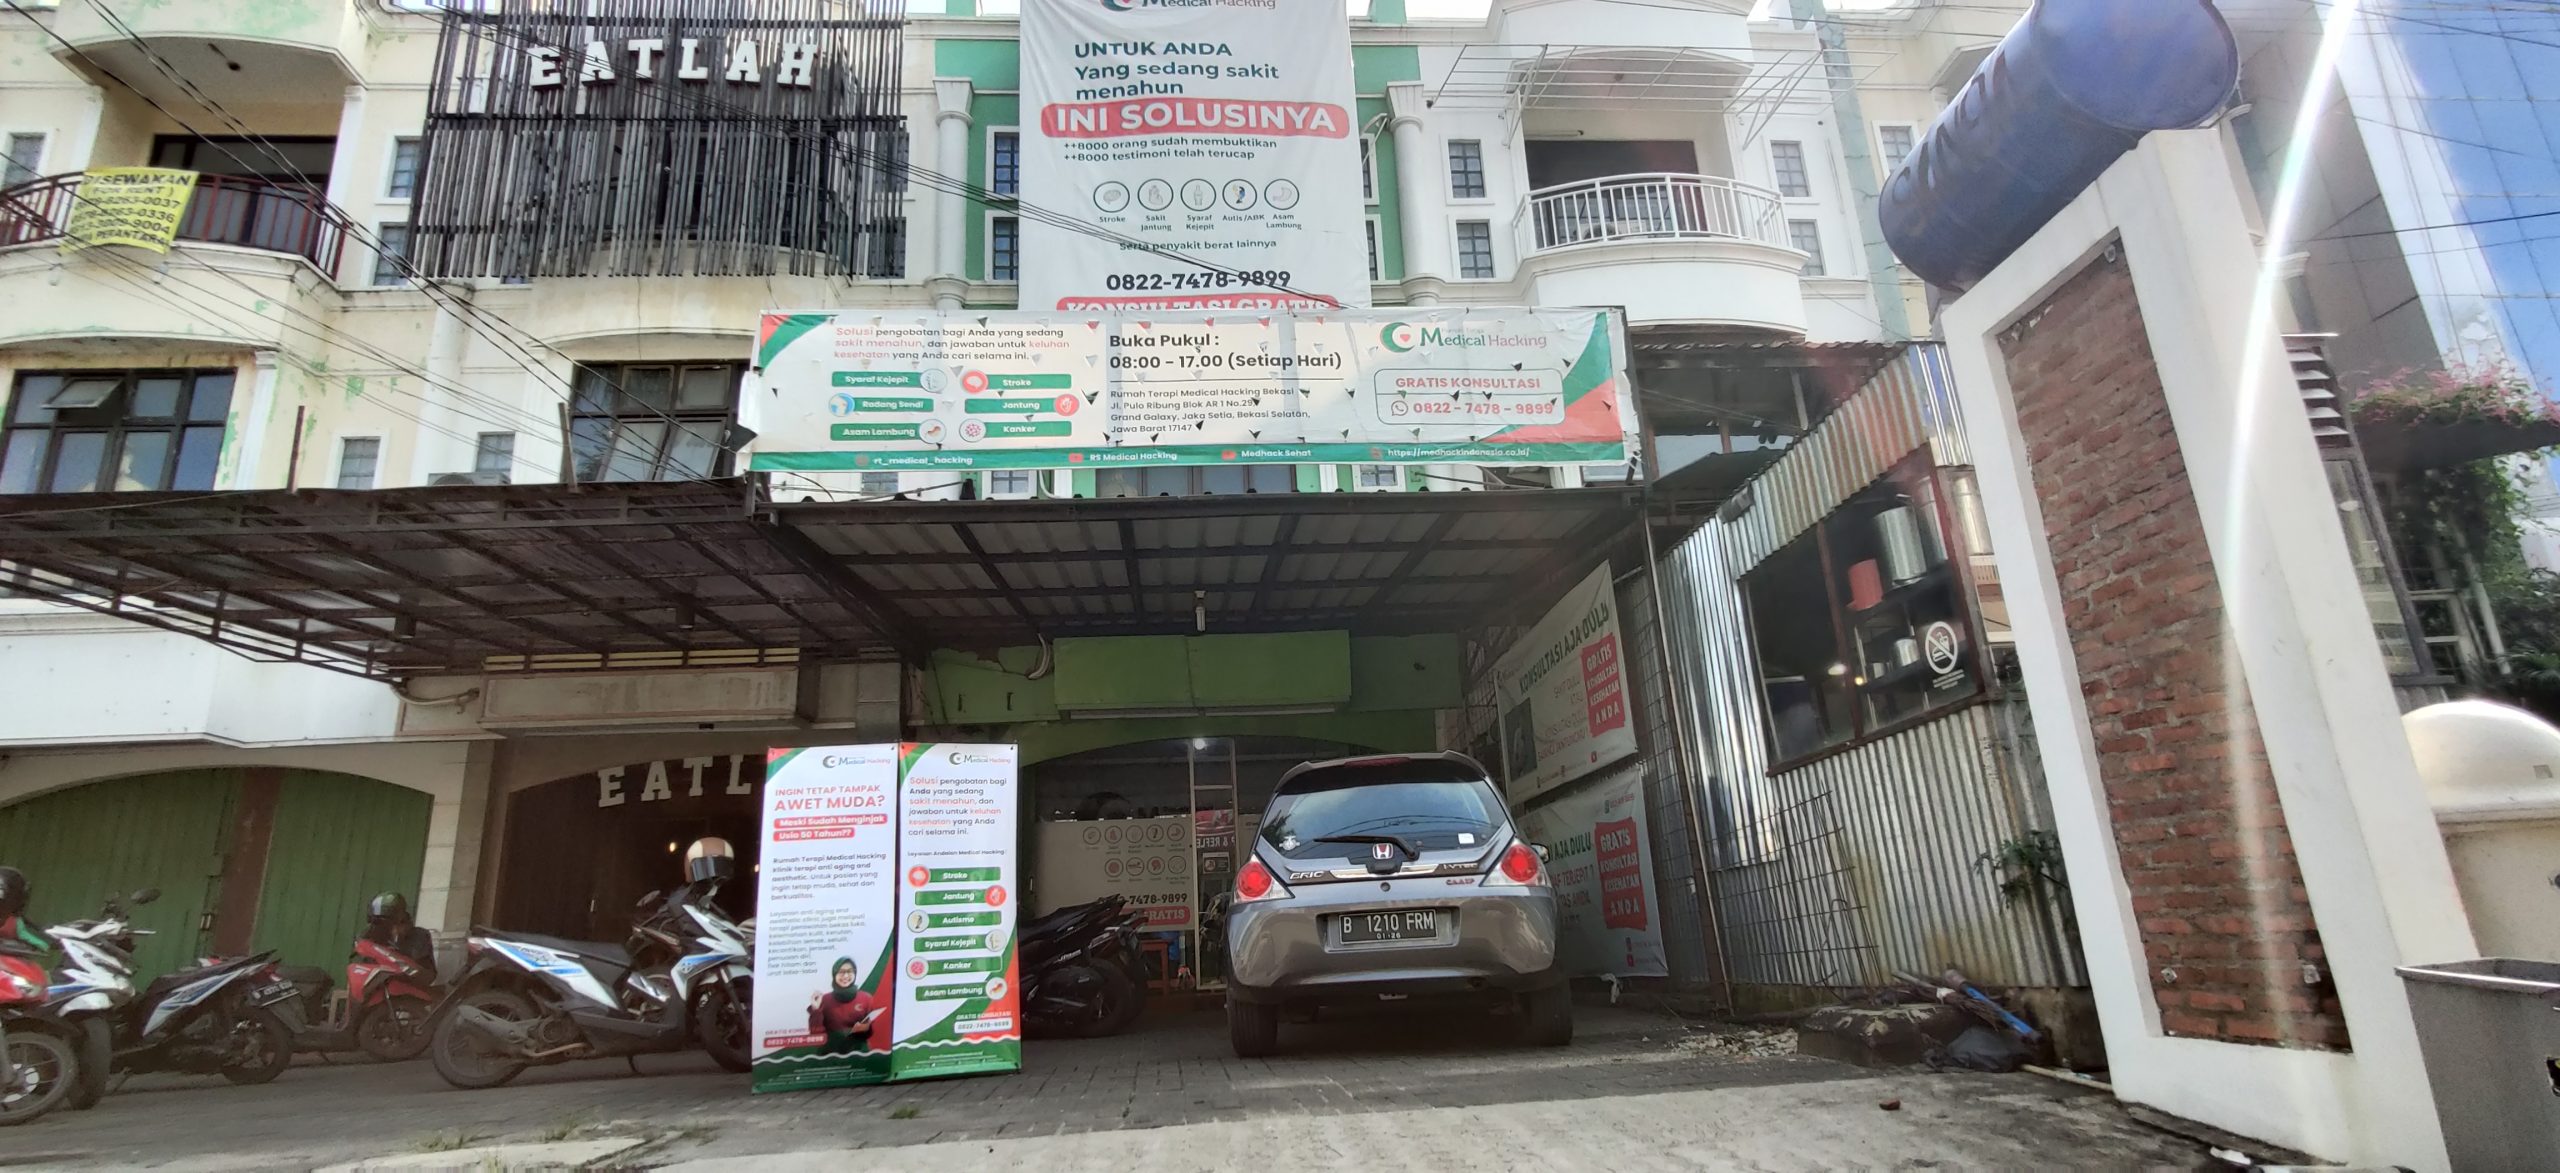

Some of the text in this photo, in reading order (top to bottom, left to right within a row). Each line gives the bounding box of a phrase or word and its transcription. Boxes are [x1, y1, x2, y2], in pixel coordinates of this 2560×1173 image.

[1075, 41, 1233, 58] UNTUK ANDA
[527, 38, 818, 90] EATLAH
[1075, 61, 1280, 80] Yang sedang sakit
[1076, 80, 1184, 100] menahun
[1057, 101, 1337, 132] INI SOLUSINYA
[1112, 139, 1148, 150] orang
[1151, 137, 1188, 147] sudah
[1192, 137, 1277, 148] membuktikan
[1112, 149, 1171, 161] testimoni
[1174, 149, 1204, 159] telah
[1208, 150, 1255, 161] terucap
[1099, 215, 1126, 223] Stroke
[1145, 214, 1166, 222] Sakit
[1187, 214, 1213, 223] Syaraf
[1272, 213, 1294, 221] Asam
[1186, 223, 1214, 232] Kejepit
[1266, 222, 1302, 230] Lambung
[1119, 239, 1277, 251] Serta penyakit berat lainnya
[1106, 271, 1290, 291] 0822-7478-9899
[836, 327, 1064, 339] Solusi pengobatan bagi Anda yang sedang
[1420, 327, 1547, 349] Medical Hacking
[835, 339, 1070, 351] sakit menahun, dan jawaban untuk keluhan
[1110, 334, 1210, 347] Buka Pukul
[834, 351, 1029, 361] kesehatan yang Anda cari selama ini.
[1110, 352, 1341, 371] 08:00 17.00 (Setiap Hari)
[845, 375, 909, 385] Syaraf Kejepit
[1003, 378, 1031, 387] Stroke
[1396, 378, 1540, 389] GRATIS KONSULTASI
[1111, 387, 1294, 399] Rumah Terapi Medical Hacking Bekasi
[862, 400, 924, 411] Radang Sendi
[1002, 401, 1040, 411] Jantung
[1124, 400, 1144, 409] Pulo
[1147, 400, 1180, 411] Ribung
[1183, 400, 1203, 408] Blok
[1206, 400, 1218, 408] AR
[1413, 403, 1552, 415] 0822 7478 9899
[1111, 410, 1311, 422] Grand Galaxy, Jaka Setia, Bekasi Selatan,
[843, 427, 915, 438] Asam Lambung
[1003, 424, 1036, 433] Kanker
[1111, 424, 1192, 433] Jawa Barat 17147
[874, 455, 973, 466] rt_medical_hacking
[1103, 453, 1138, 461] Medical
[1140, 452, 1177, 462] Hacking
[1519, 639, 1564, 696] KONSULTASI
[1563, 626, 1582, 657] AJA
[1582, 602, 1610, 641] DULU
[1586, 642, 1613, 673] GRATIS
[1588, 662, 1618, 691] KONSULTASI
[1589, 681, 1620, 707] KESEHATAN
[598, 754, 752, 808] EATL
[910, 777, 1007, 787] Solusi pengobatan bagi
[776, 785, 881, 796] INGIN TETAP TAMPAK
[954, 788, 984, 796] sedang
[775, 795, 885, 811] AWET MUDA?
[780, 817, 806, 826] Meski
[838, 815, 885, 825] Menginjak
[1571, 832, 1592, 854] DULU
[1600, 829, 1630, 851] GRATIS
[1600, 852, 1637, 874] KONSULTASI
[943, 872, 968, 880] Stroke
[1343, 911, 1434, 934] B 1210 FRM
[925, 939, 976, 949] Syaraf Kejepit
[943, 962, 972, 970] Kanker
[947, 987, 983, 996] Lambung
